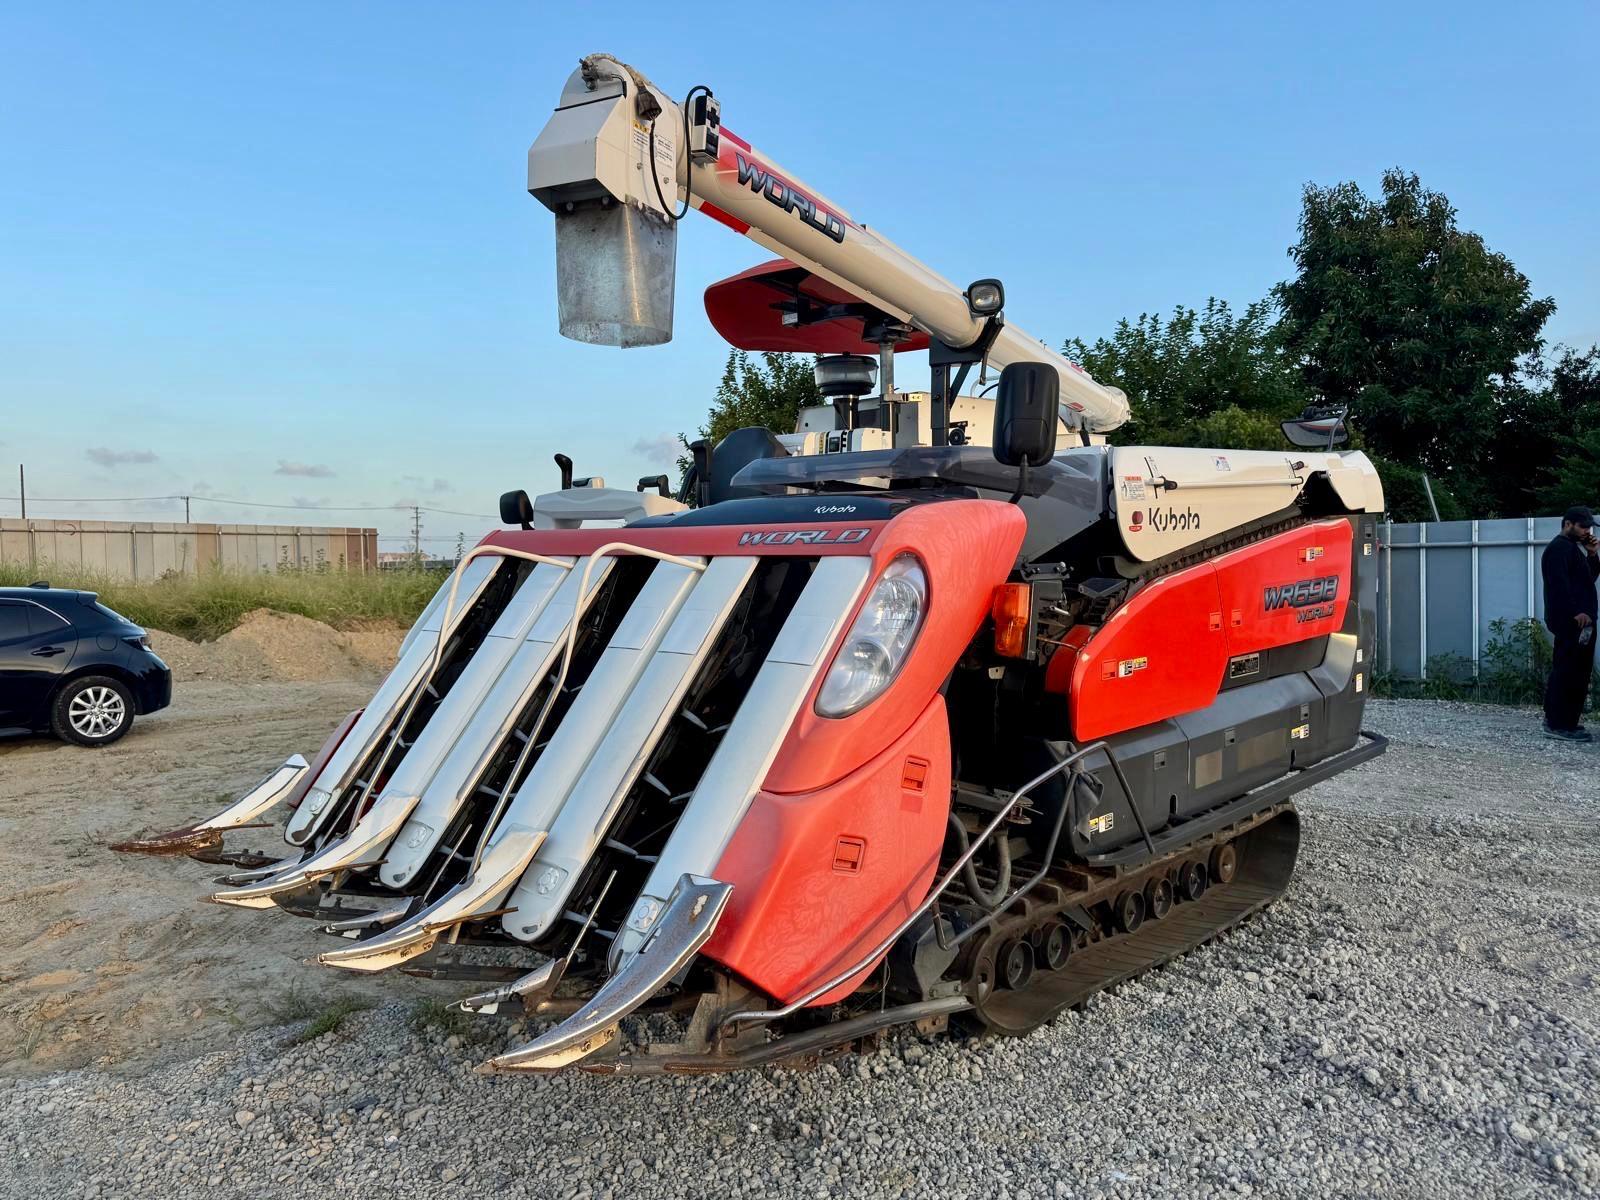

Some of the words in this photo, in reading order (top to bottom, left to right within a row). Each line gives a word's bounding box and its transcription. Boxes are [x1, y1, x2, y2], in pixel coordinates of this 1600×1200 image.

[736, 152, 846, 244] WORLD
[814, 504, 857, 514] Kubota
[1148, 506, 1201, 532] Kubota
[738, 527, 872, 546] WORLD
[1296, 603, 1335, 624] WORLD
